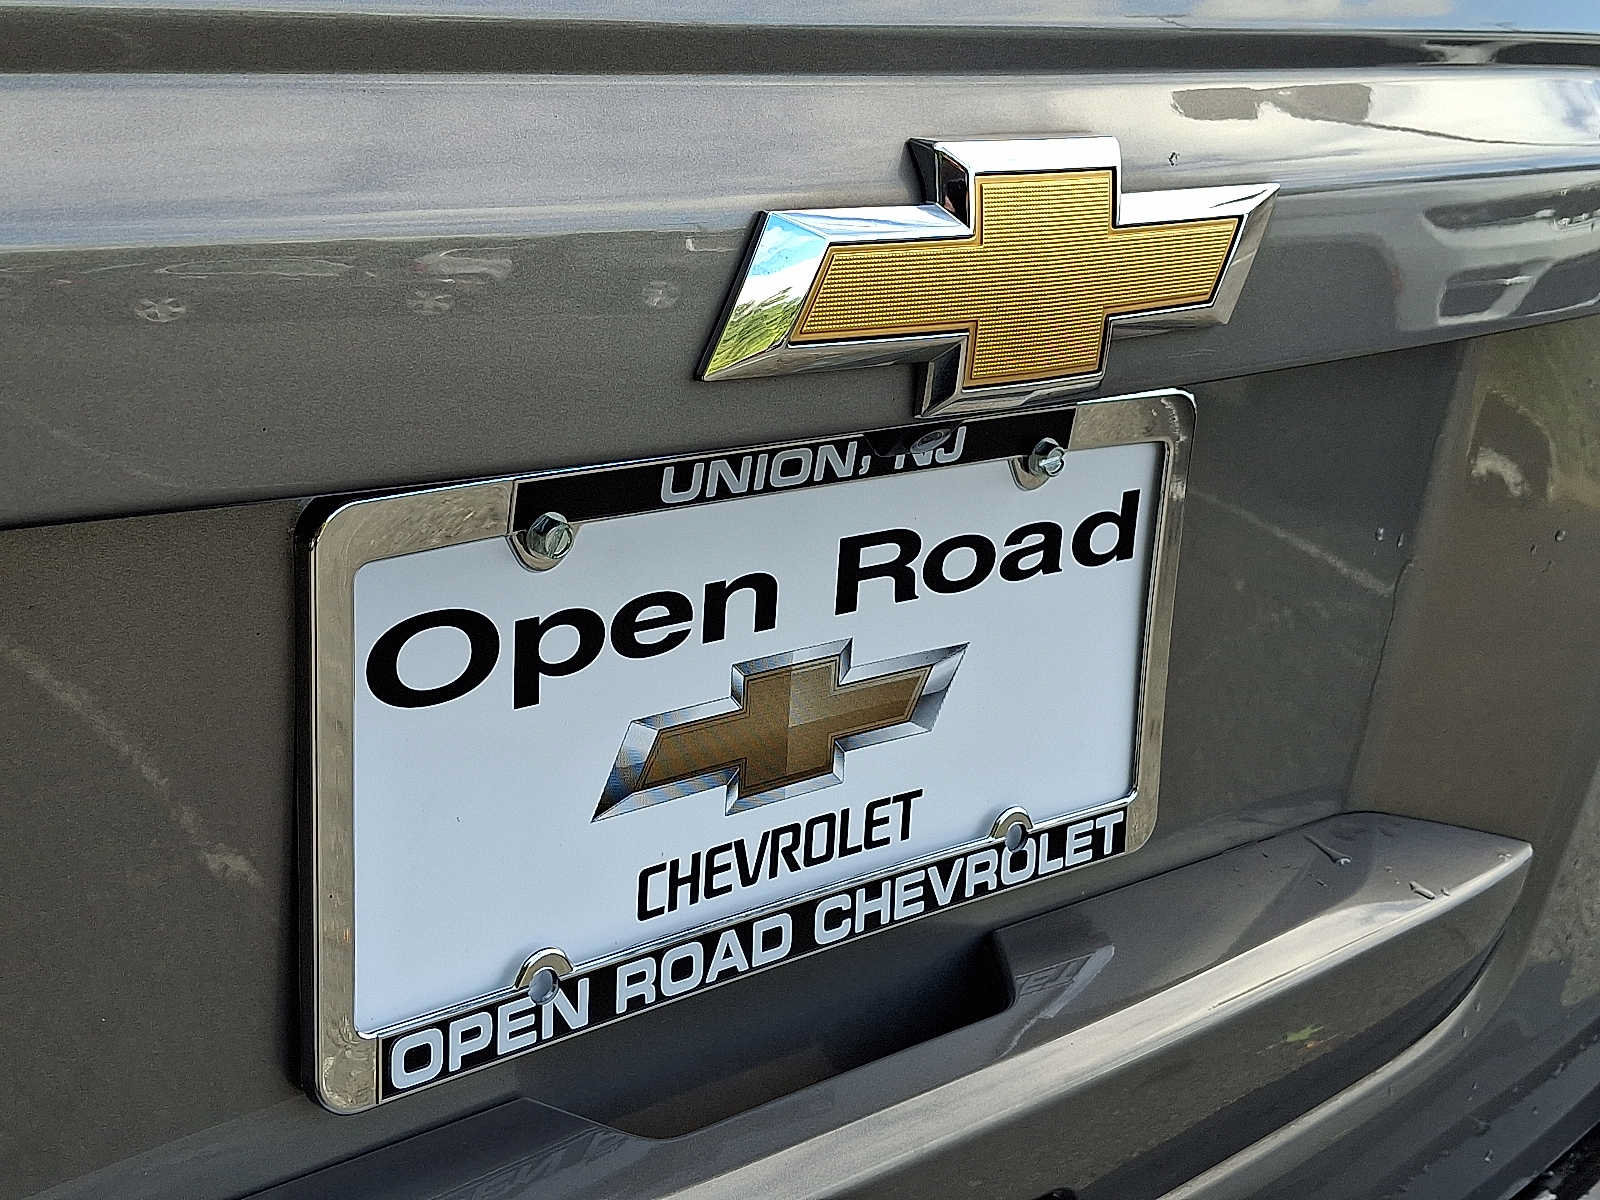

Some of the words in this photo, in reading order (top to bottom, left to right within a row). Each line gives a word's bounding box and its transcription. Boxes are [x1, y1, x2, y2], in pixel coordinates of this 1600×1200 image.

[660, 441, 871, 504] UNION,
[366, 572, 778, 709] Open
[834, 489, 1141, 615] Road
[637, 789, 923, 922] CHEVROLET
[391, 977, 589, 1089] OPEN
[615, 912, 792, 1014] ROAD
[813, 811, 1124, 945] CHEVROLET
